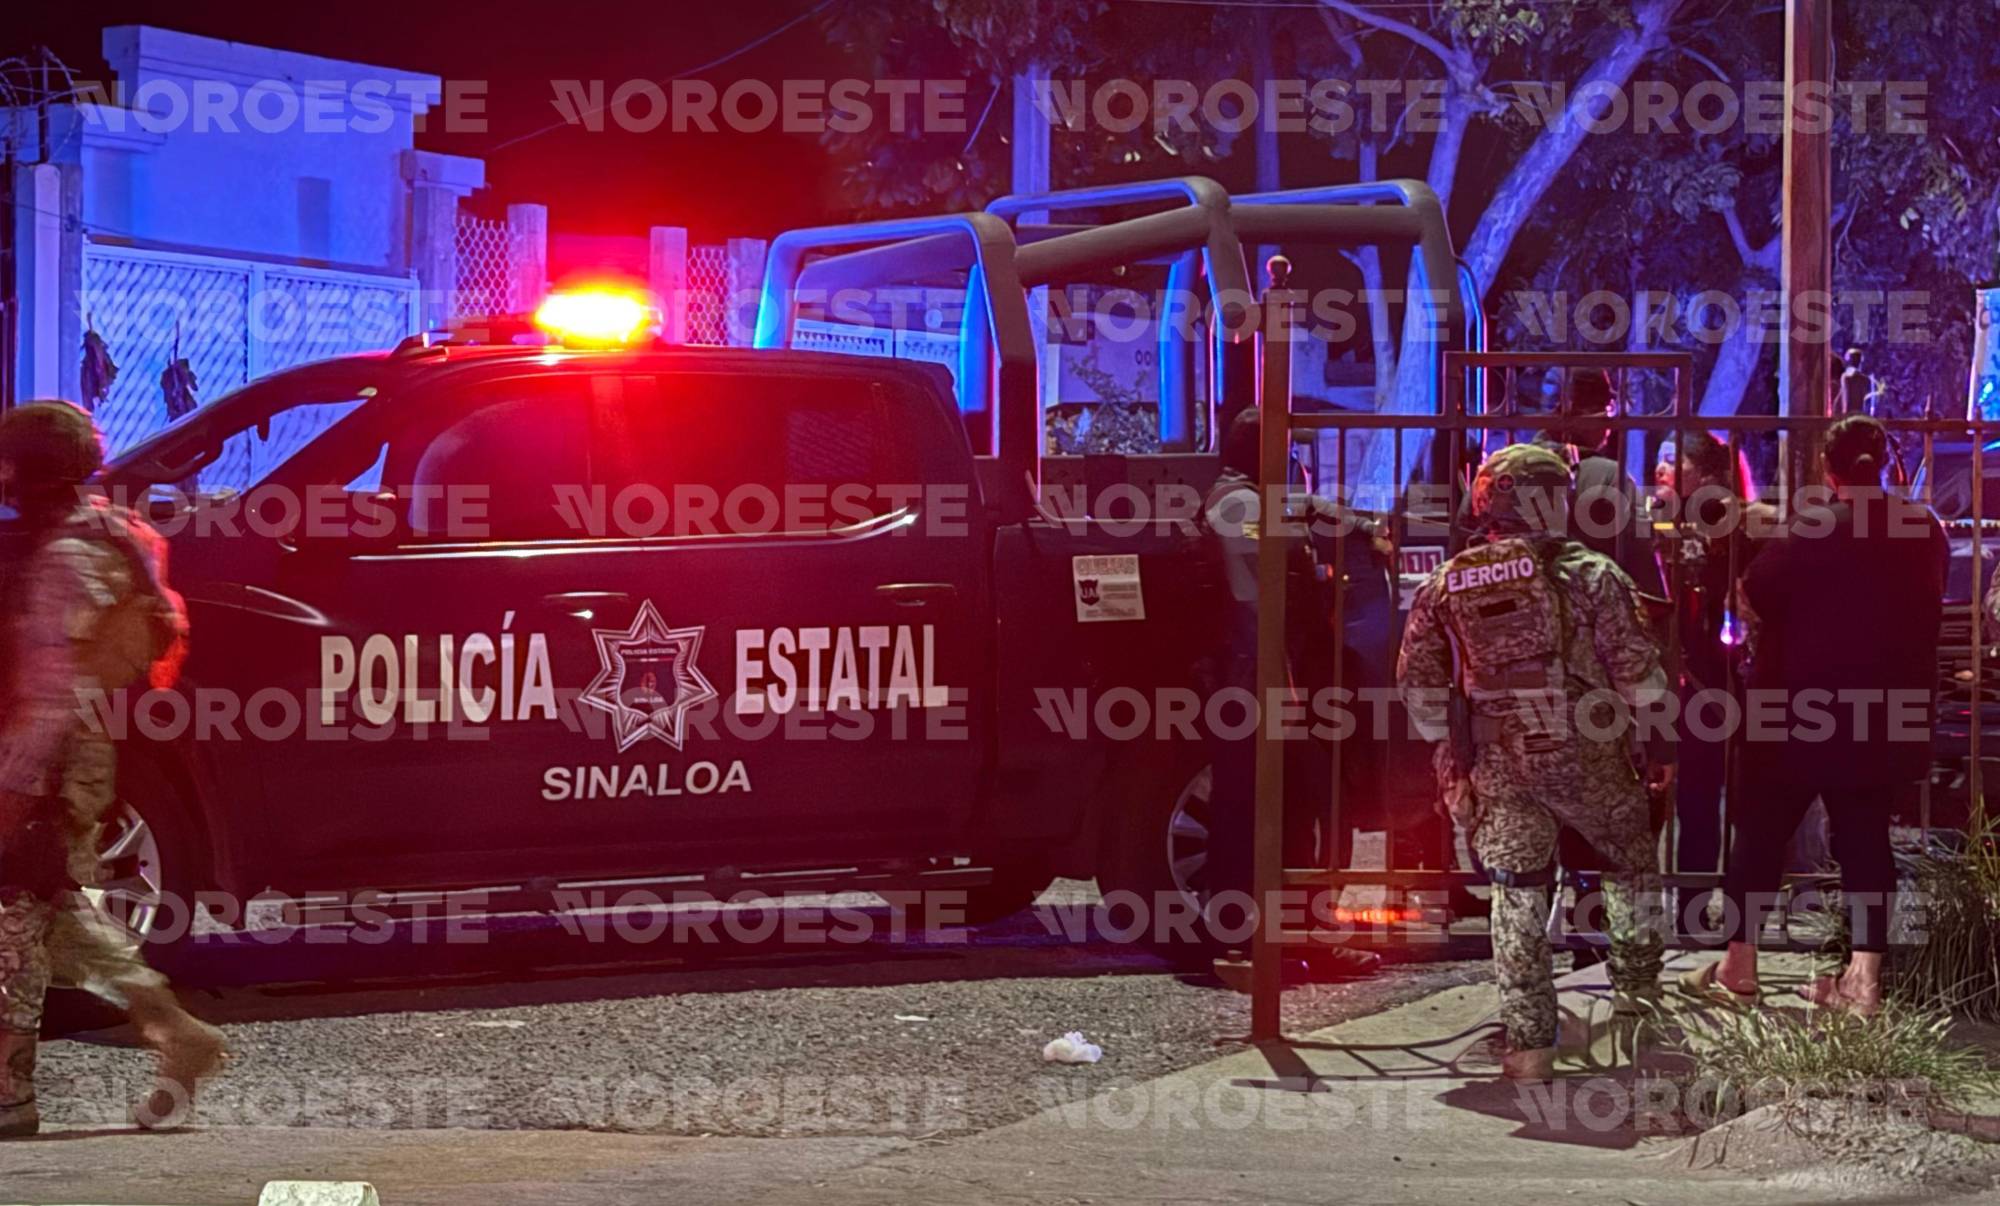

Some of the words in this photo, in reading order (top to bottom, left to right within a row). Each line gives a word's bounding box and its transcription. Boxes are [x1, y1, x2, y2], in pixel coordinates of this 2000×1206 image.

[1446, 557, 1535, 593] EJERCITO
[319, 611, 557, 726] POLICÍA
[735, 624, 950, 715] ESTATAL
[542, 761, 752, 802] SINALOA
